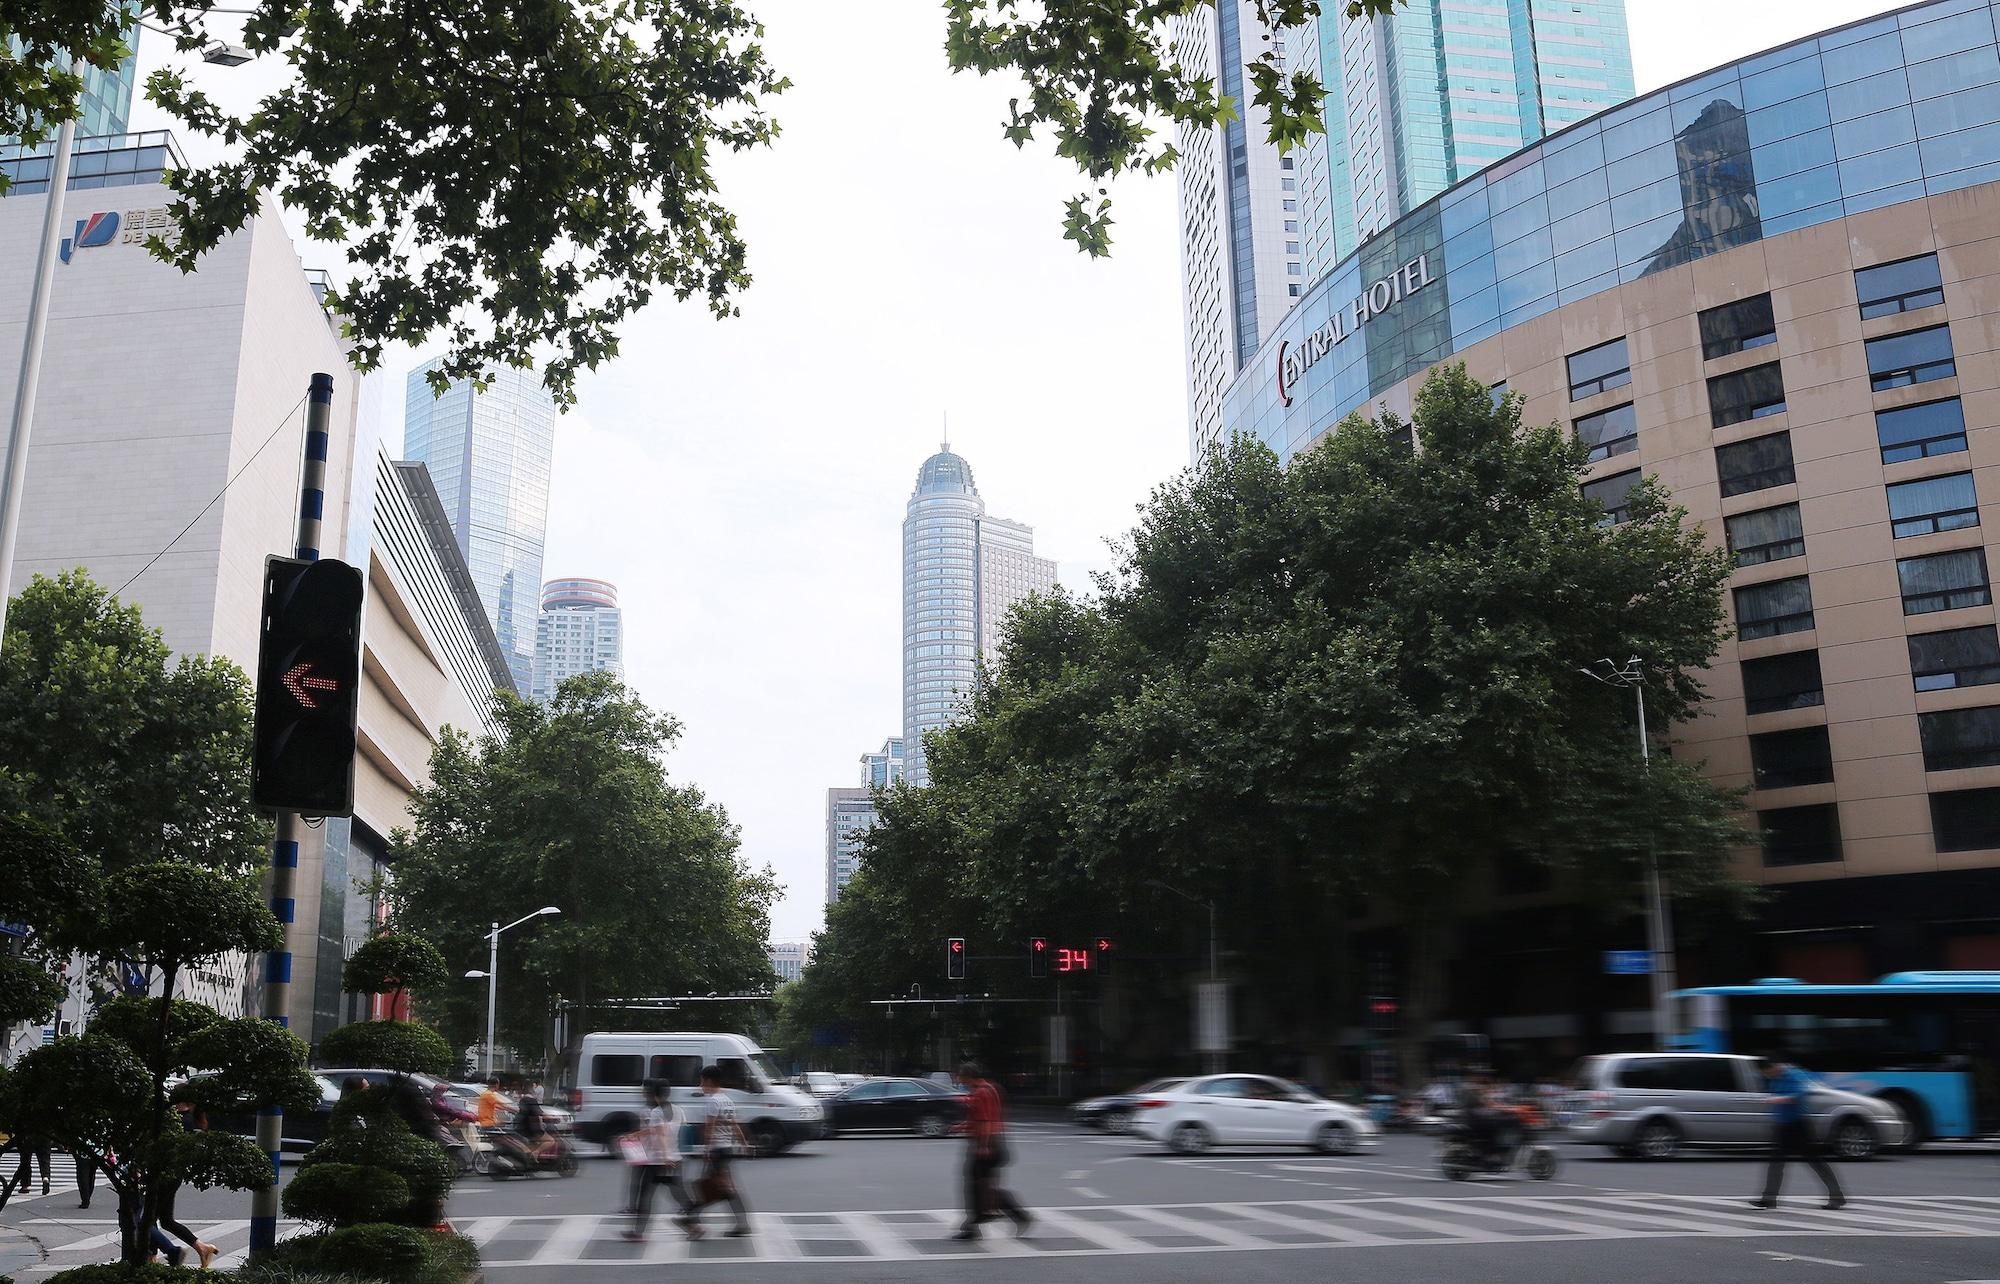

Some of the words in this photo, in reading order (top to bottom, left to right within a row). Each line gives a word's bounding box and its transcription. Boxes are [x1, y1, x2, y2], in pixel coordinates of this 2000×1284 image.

[122, 230, 160, 243] DE
[1278, 313, 1349, 406] CENTRAL
[1353, 255, 1436, 328] HOTEL
[1059, 949, 1088, 971] 34
